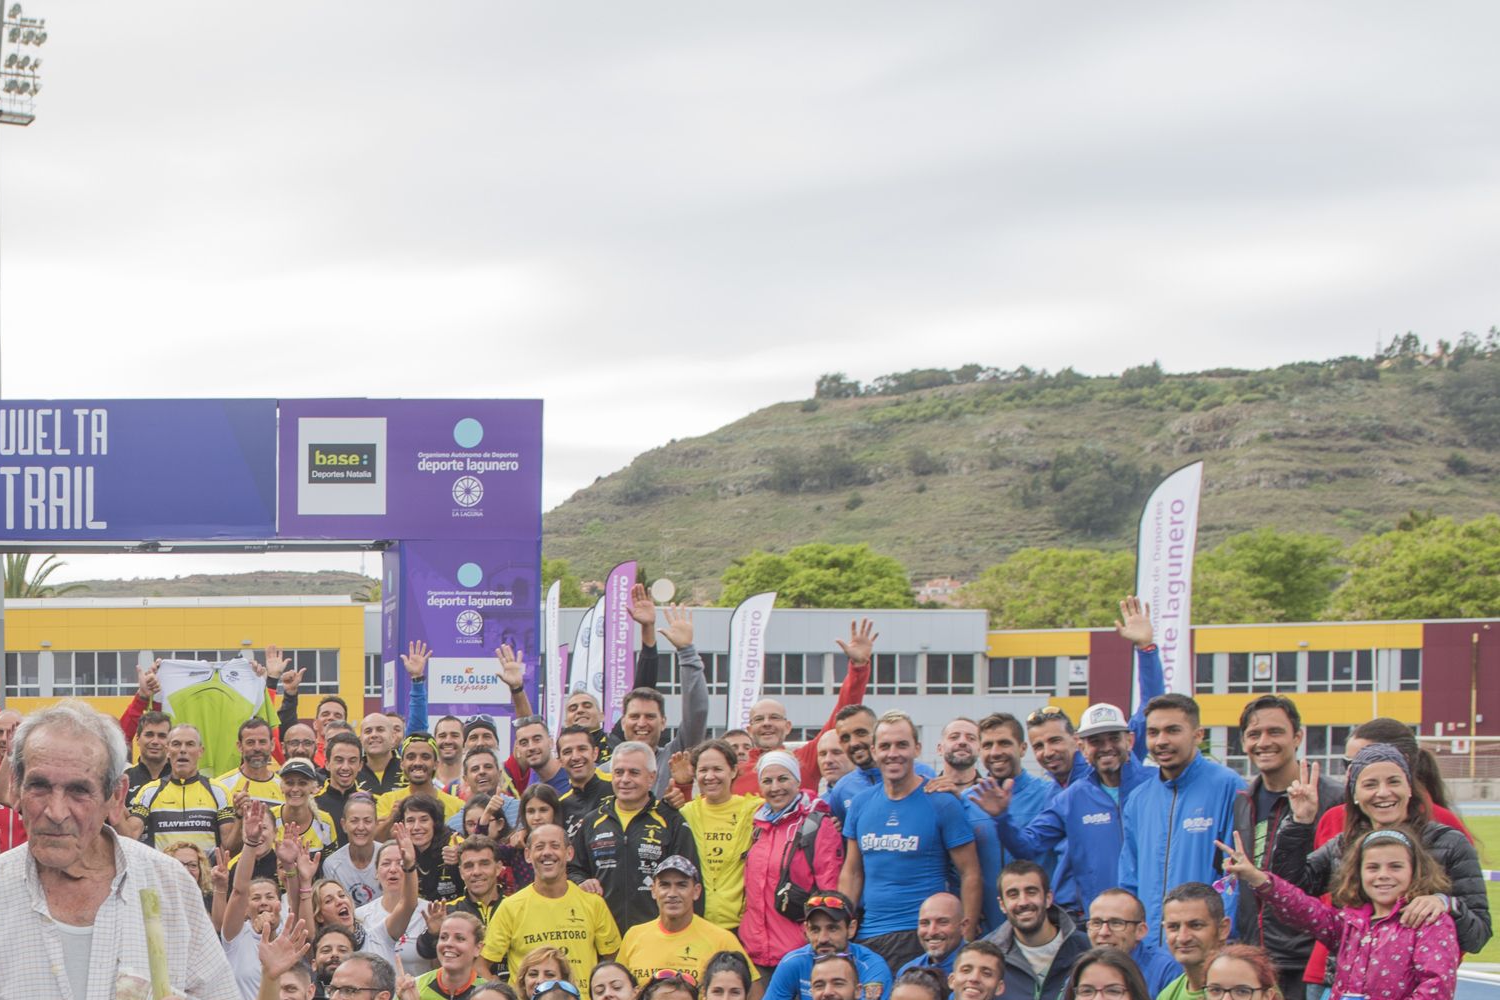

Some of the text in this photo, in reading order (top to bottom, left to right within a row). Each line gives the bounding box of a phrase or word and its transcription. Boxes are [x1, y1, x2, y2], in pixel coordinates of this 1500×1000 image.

[311, 470, 372, 479] Deportes Natalia
[417, 458, 519, 474] deporte lagunero
[0, 466, 107, 530] TRAIL
[1153, 501, 1164, 560] Deportes
[1153, 565, 1161, 582] de
[1161, 498, 1186, 619] lagunero
[427, 596, 513, 609] deporte lagunero
[618, 575, 629, 646] lagunero
[742, 610, 762, 682] lagunero
[453, 684, 488, 694] Express
